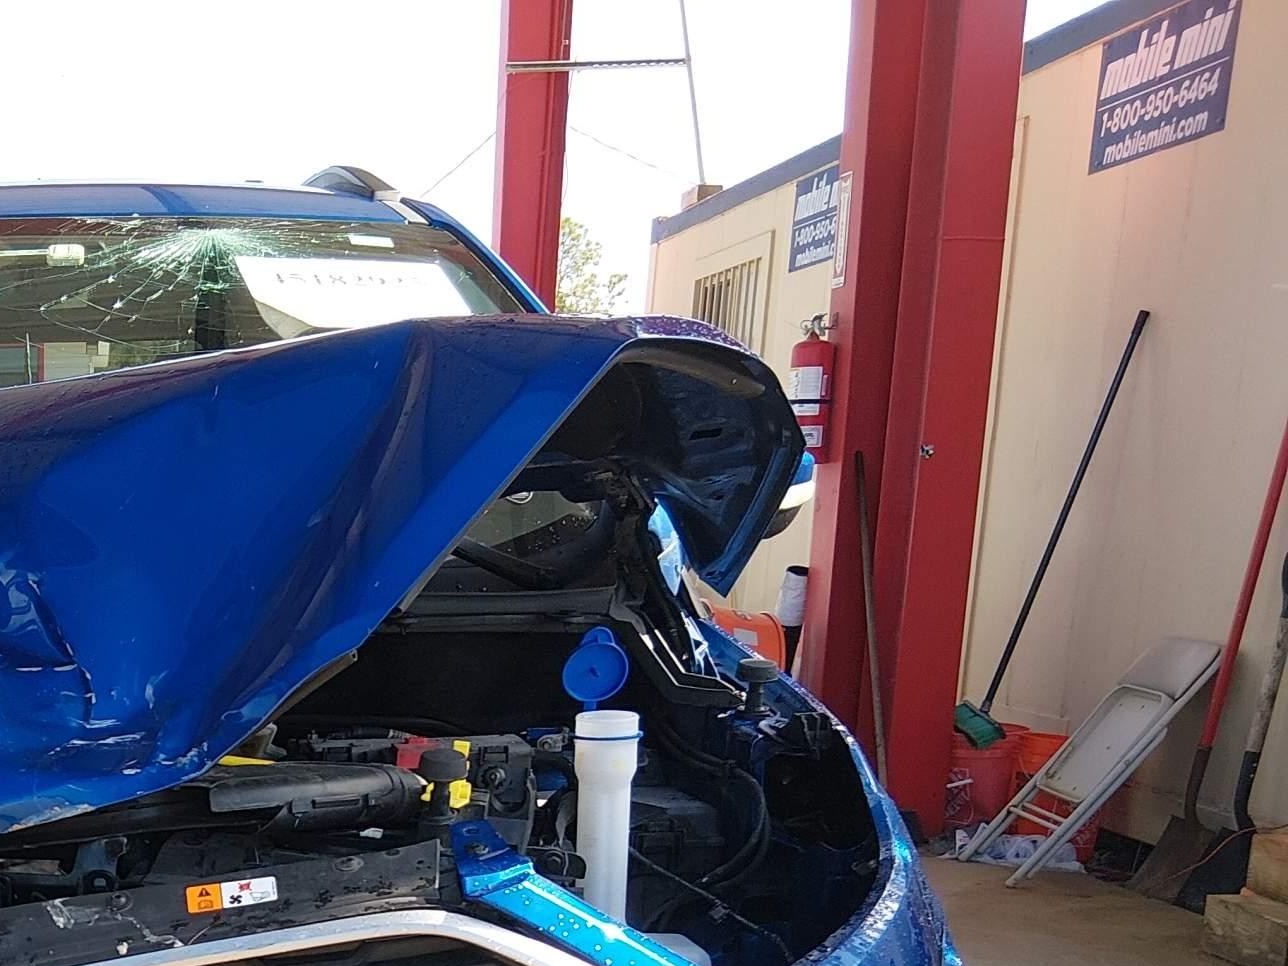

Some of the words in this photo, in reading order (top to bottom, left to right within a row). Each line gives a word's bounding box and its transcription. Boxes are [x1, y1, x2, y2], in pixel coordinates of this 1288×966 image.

[1100, 19, 1176, 100] mobile
[1172, 0, 1237, 70] mini
[1100, 67, 1221, 137] 1-800-950-6464
[1103, 111, 1208, 165] mobilemini.com
